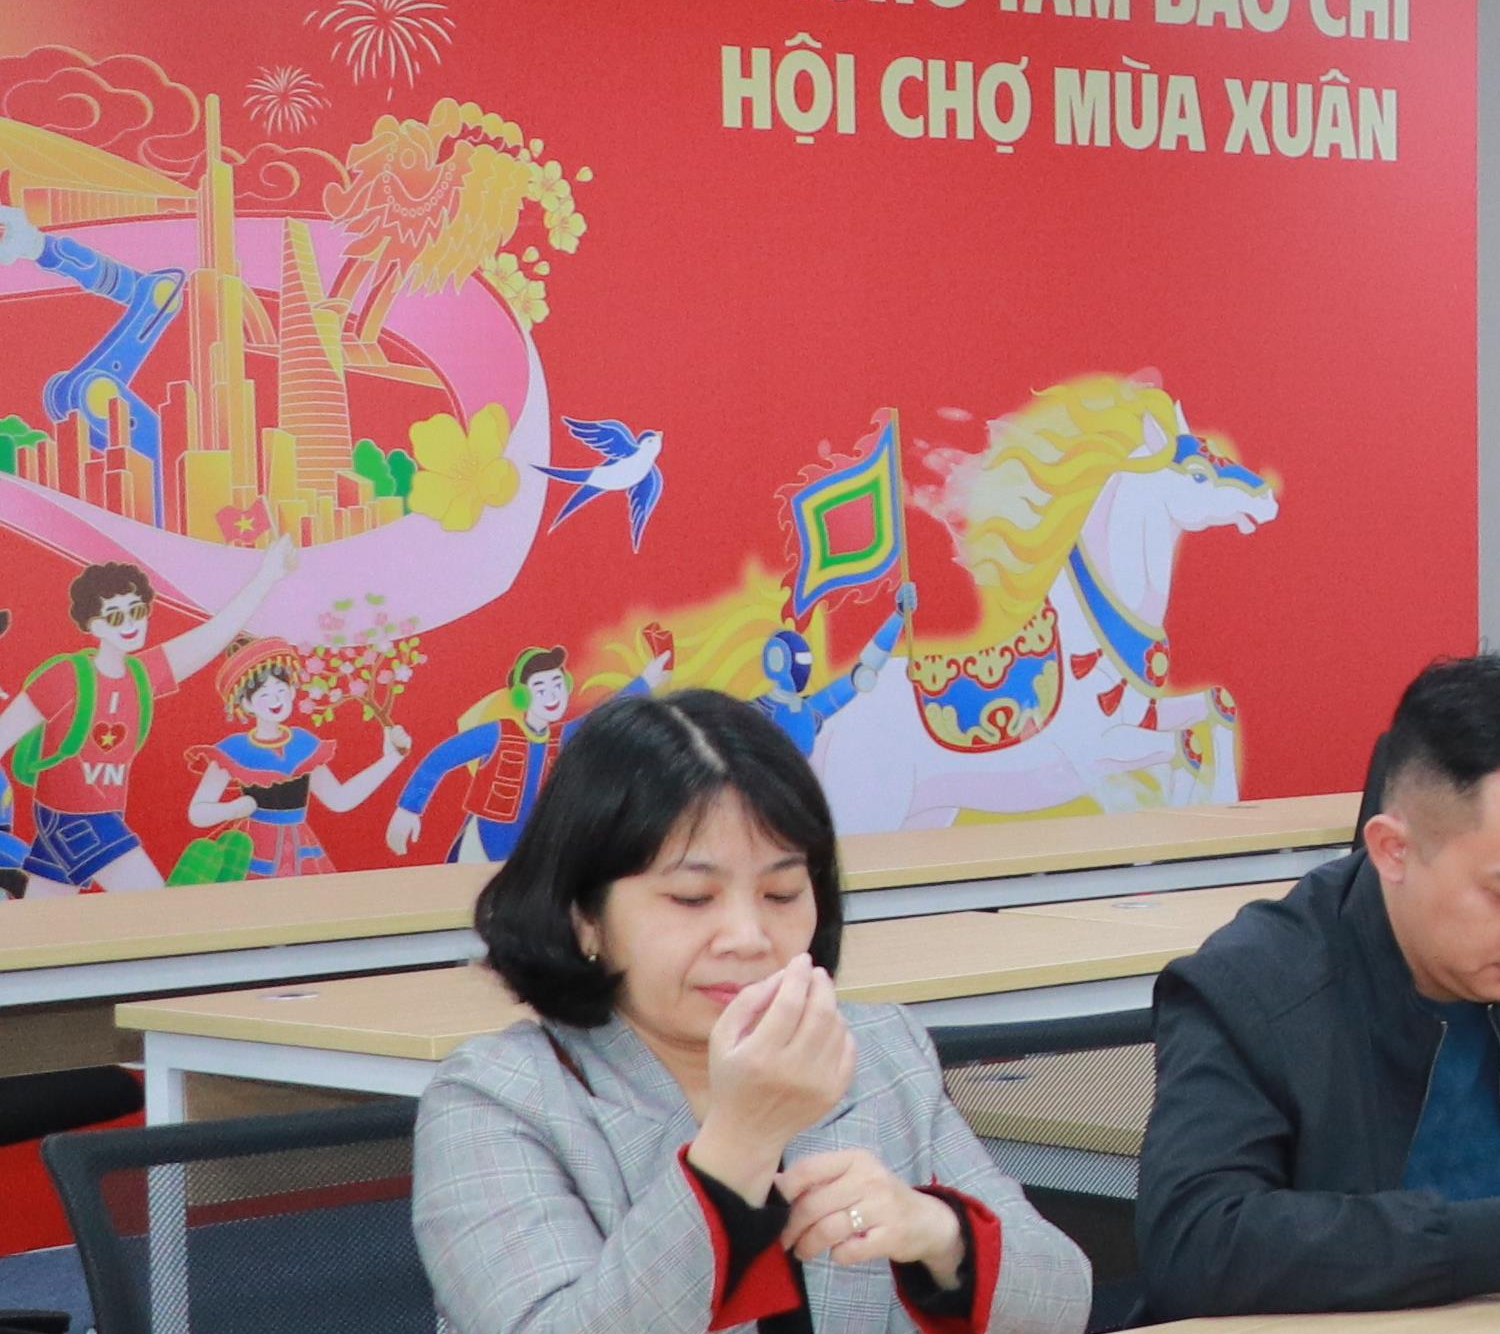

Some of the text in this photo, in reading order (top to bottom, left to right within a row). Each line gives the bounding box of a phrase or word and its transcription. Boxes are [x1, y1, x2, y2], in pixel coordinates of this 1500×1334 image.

[721, 32, 1397, 161] HỘI CHỢ MÙA XUÂN
[83, 762, 126, 785] VN
